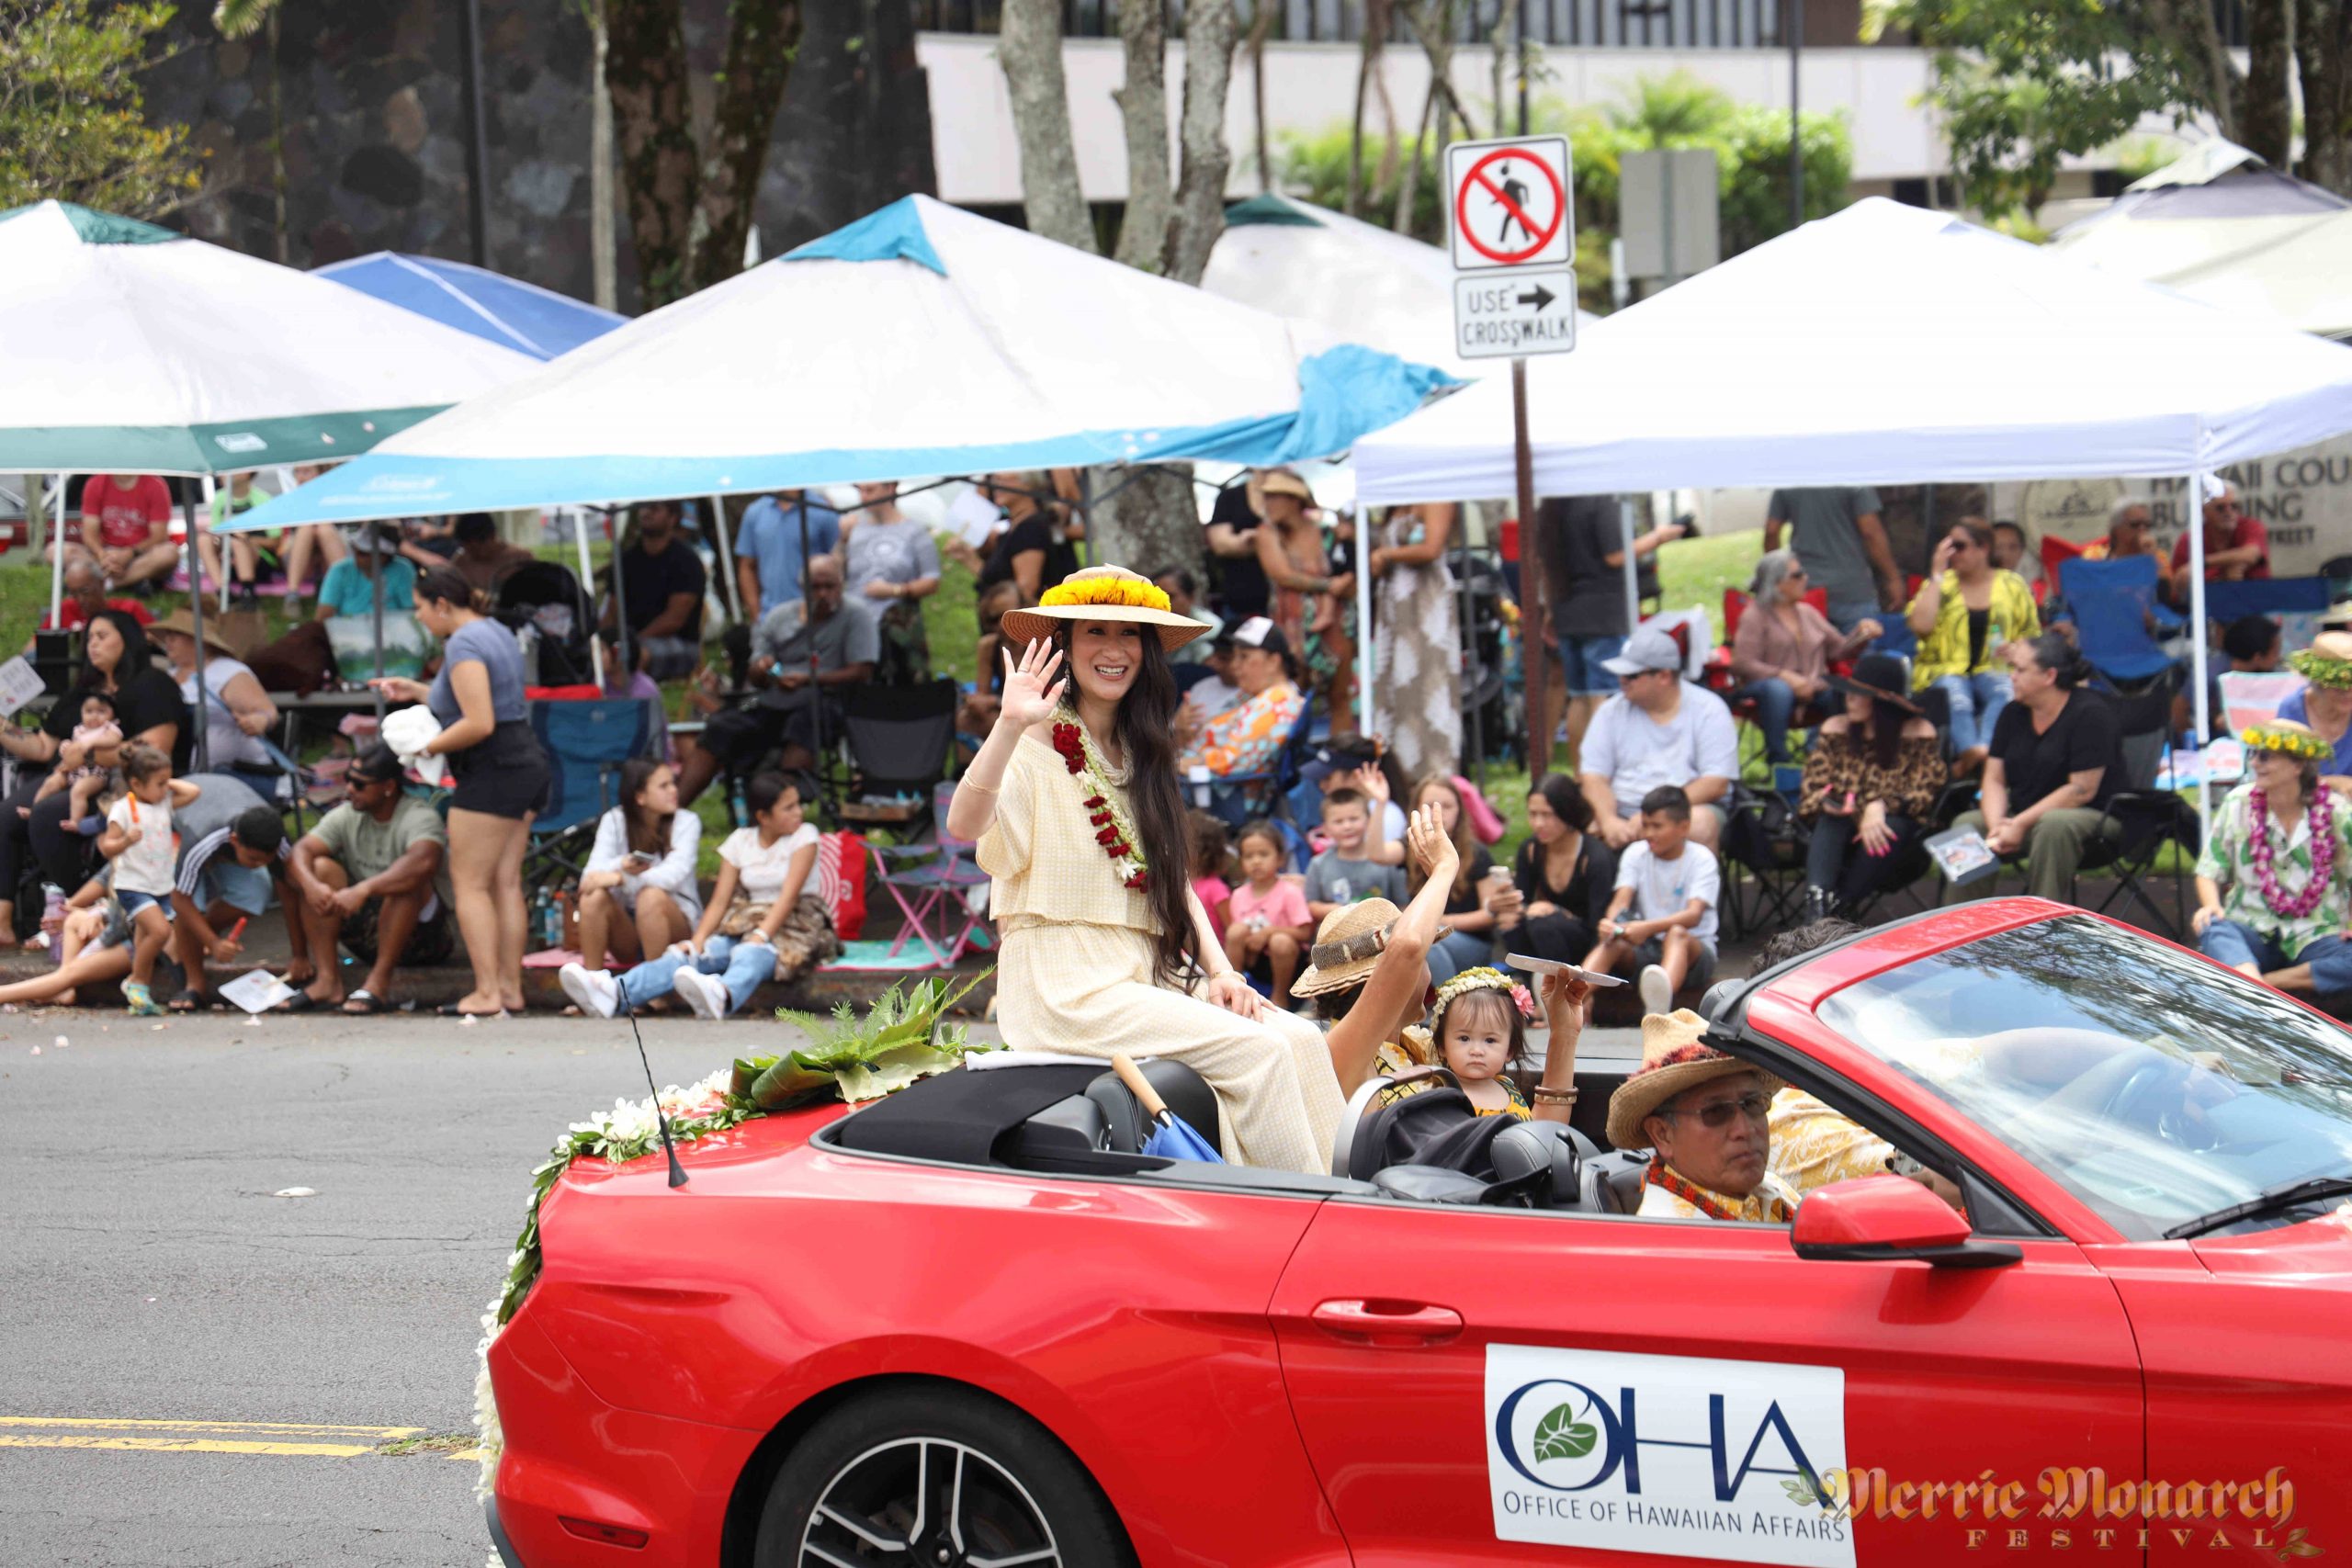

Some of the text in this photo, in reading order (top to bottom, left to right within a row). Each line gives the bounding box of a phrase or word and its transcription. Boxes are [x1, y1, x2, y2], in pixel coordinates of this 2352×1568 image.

[1468, 289, 1510, 313] USE
[1464, 318, 1570, 345] CROSSWALK
[2152, 492, 2303, 528] BUING
[1495, 1379, 1839, 1510] OHA
